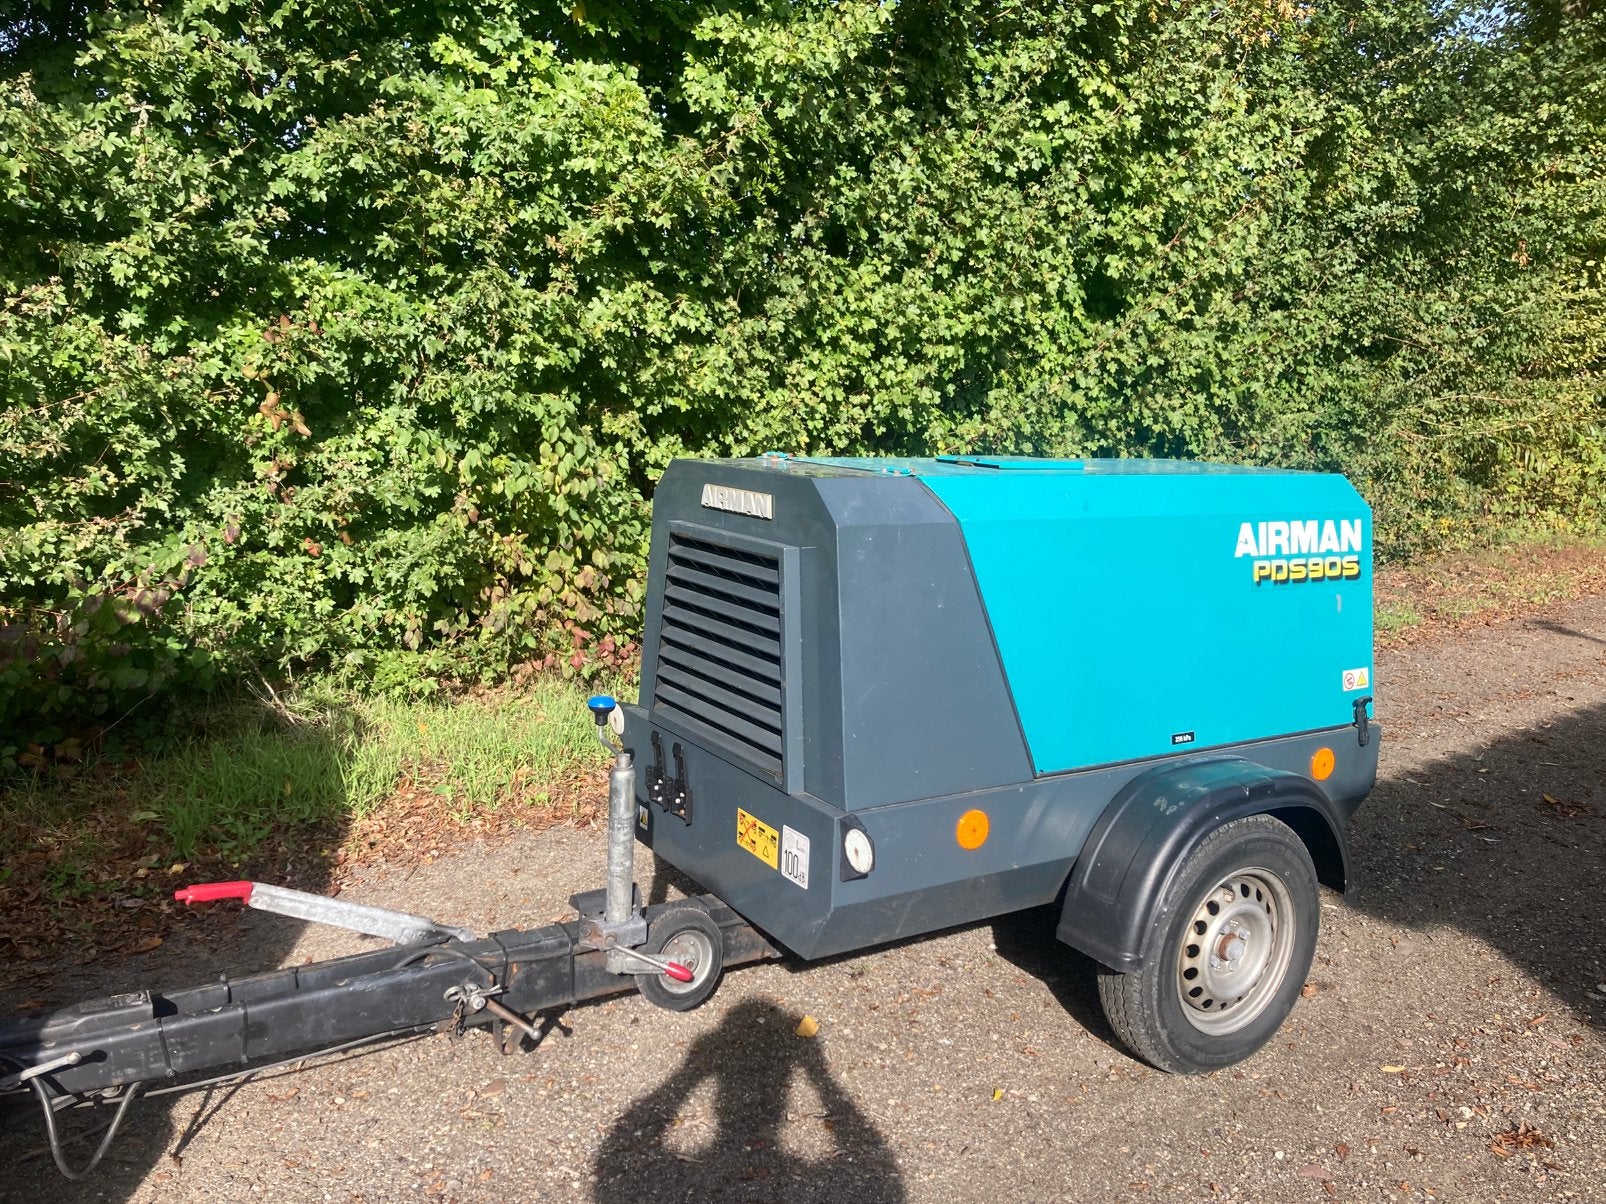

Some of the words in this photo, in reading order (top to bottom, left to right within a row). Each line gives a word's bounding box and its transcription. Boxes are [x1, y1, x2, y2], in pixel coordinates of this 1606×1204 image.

[701, 483, 772, 520] AIRMAN
[1234, 518, 1362, 558] AIRMAN
[1253, 555, 1361, 586] PDS90S
